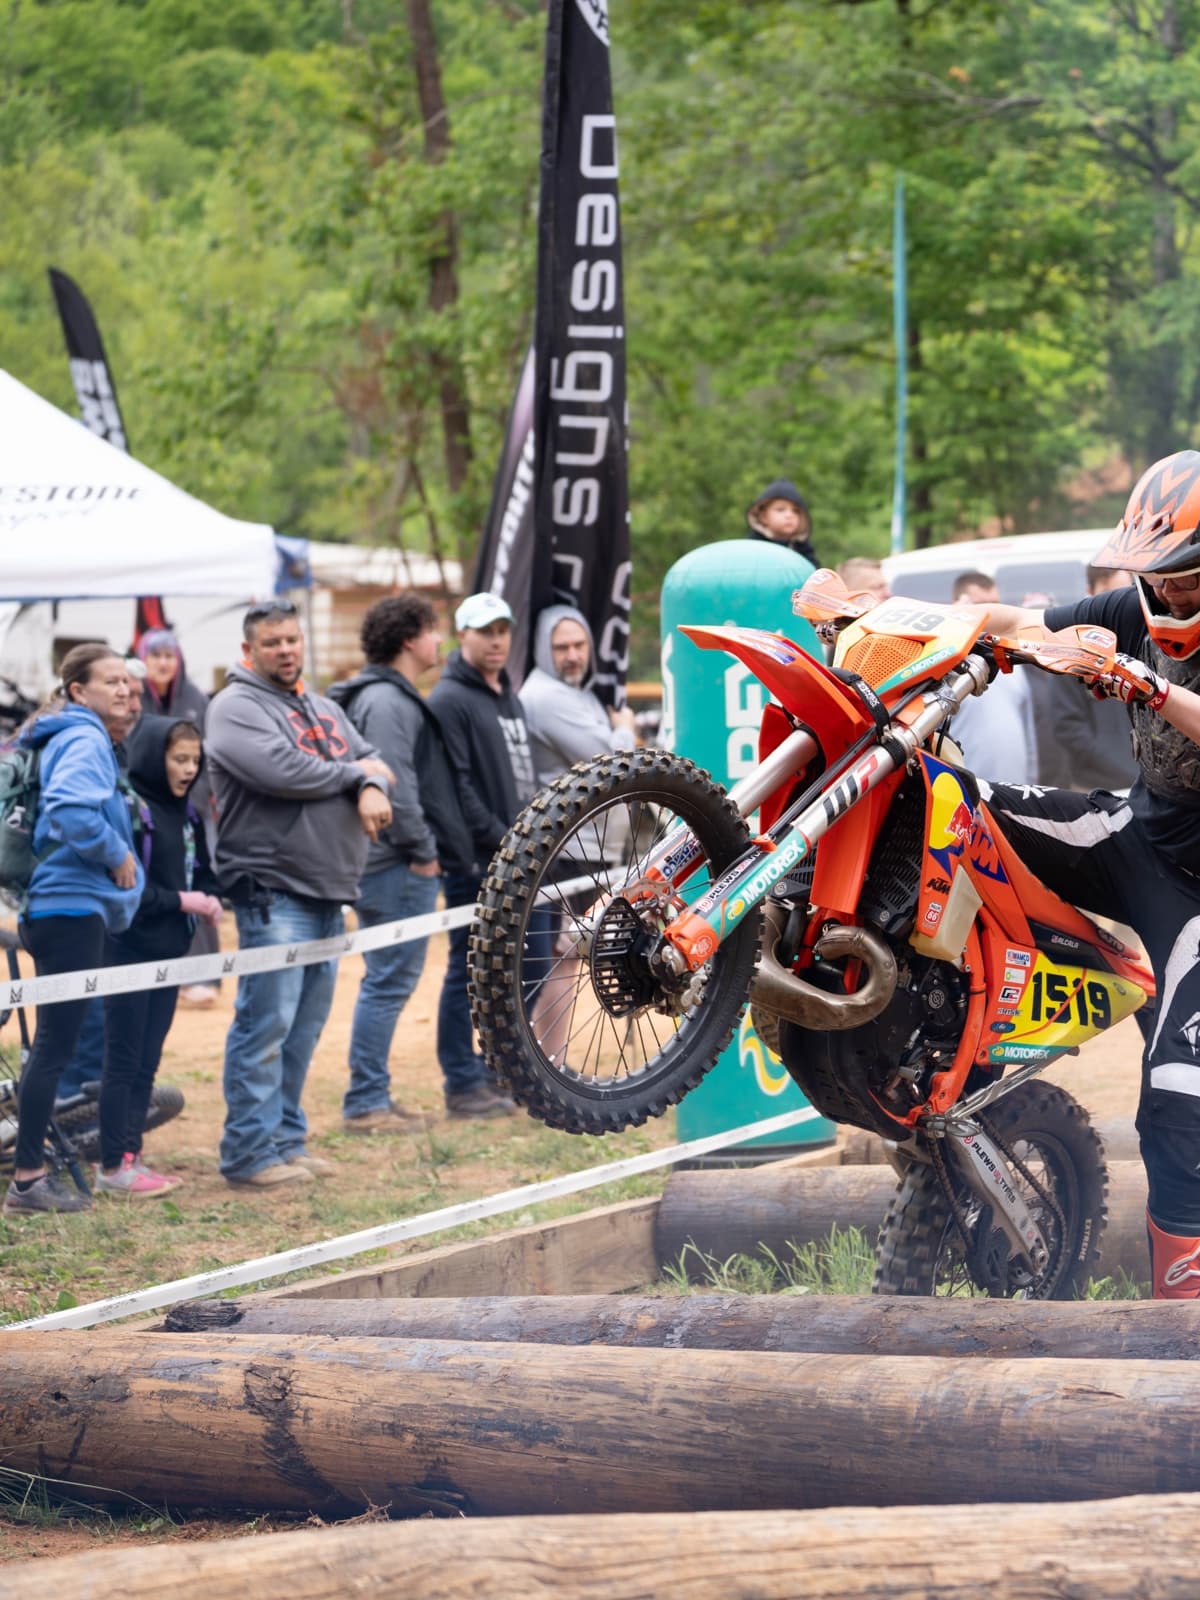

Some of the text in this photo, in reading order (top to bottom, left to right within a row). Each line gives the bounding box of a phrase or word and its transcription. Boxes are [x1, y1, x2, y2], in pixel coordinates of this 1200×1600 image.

[911, 650, 950, 674] MOTOREX
[709, 868, 740, 901] PLEWS
[742, 840, 805, 904] MOTOREX
[926, 877, 951, 895] KTM
[926, 909, 939, 922] 66
[1031, 971, 1112, 1030] 1519
[1004, 1046, 1050, 1060] MOTOREX
[971, 1142, 996, 1173] PLEWS
